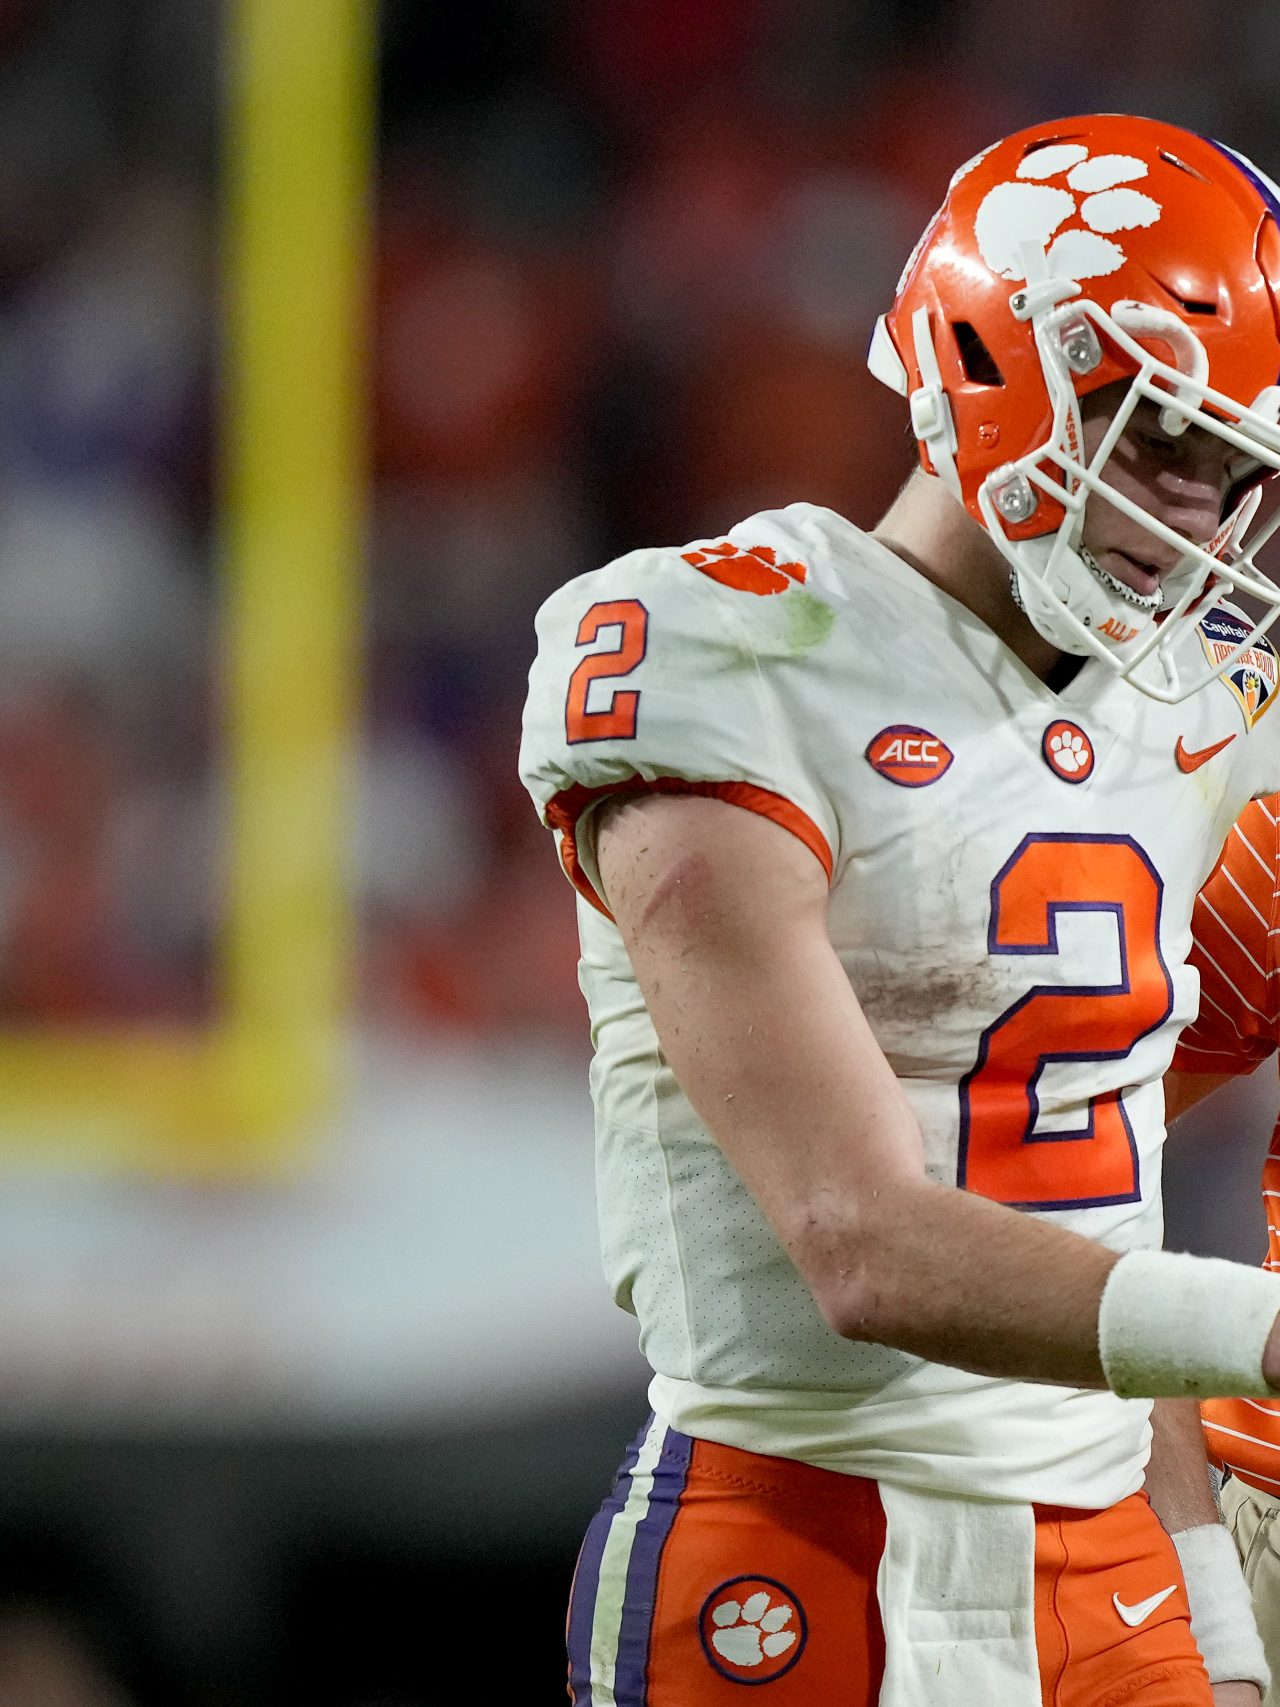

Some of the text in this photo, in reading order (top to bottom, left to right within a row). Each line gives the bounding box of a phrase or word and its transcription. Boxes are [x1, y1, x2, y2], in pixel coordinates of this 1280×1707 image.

[565, 598, 650, 746] 2
[879, 739, 940, 762] ACC
[957, 832, 1174, 1213] 2
